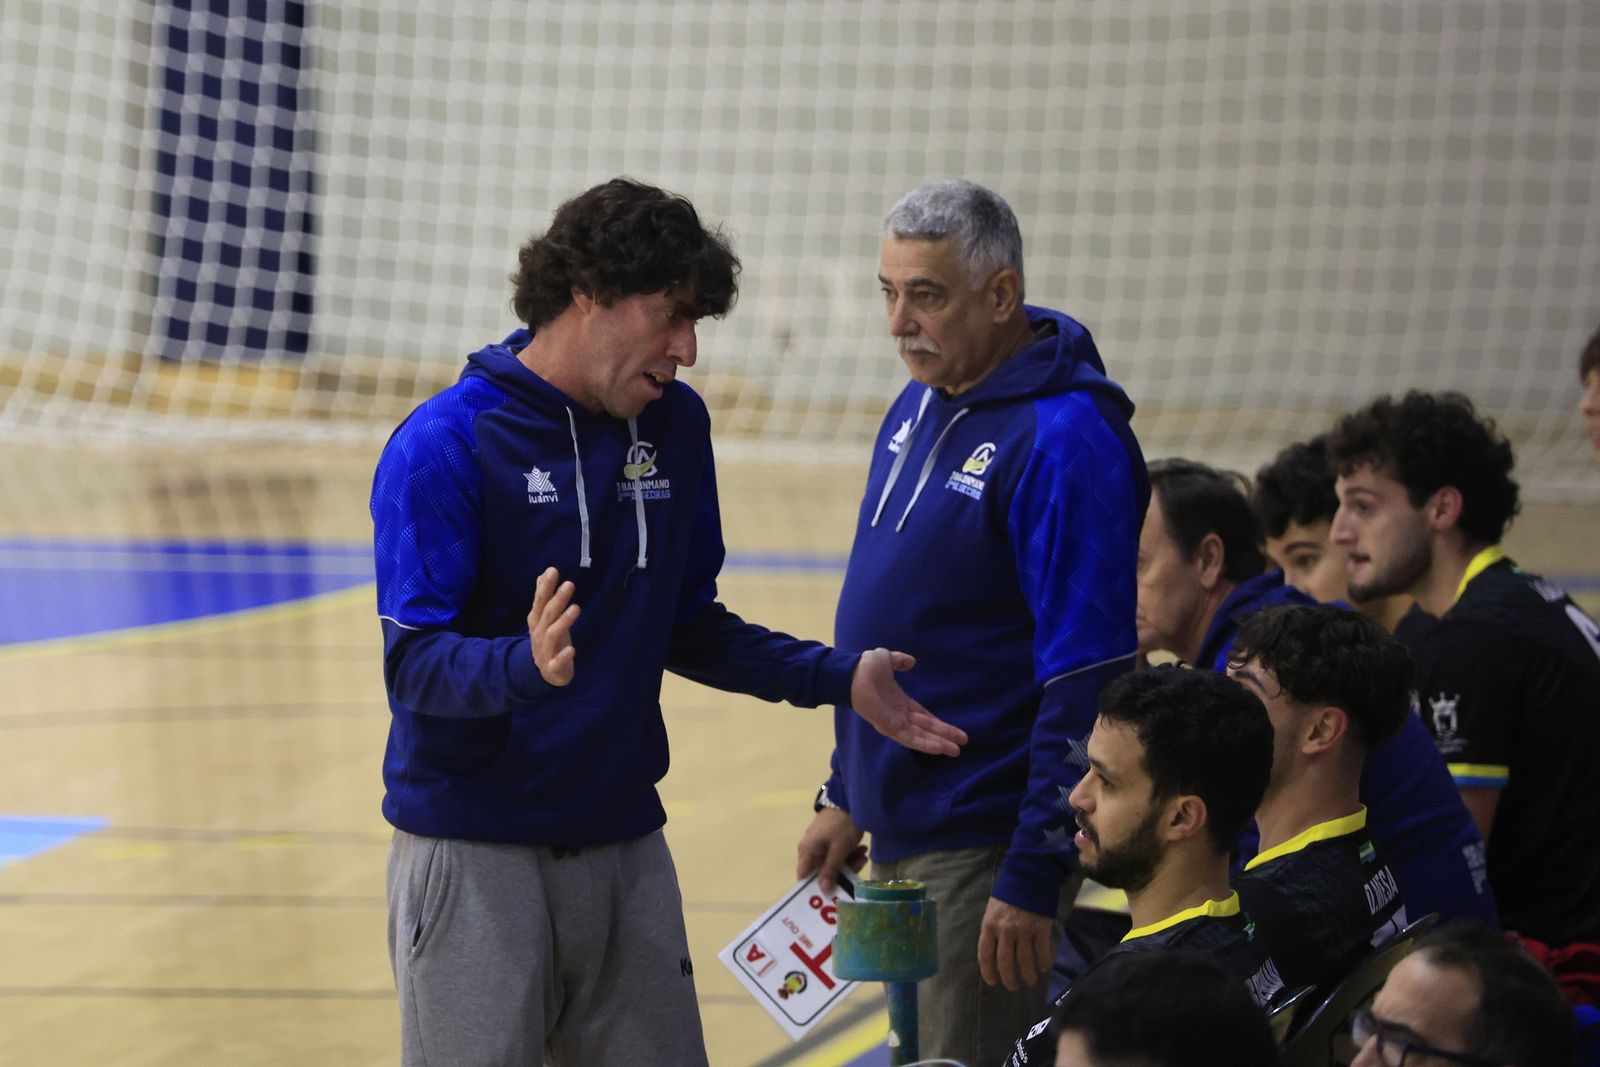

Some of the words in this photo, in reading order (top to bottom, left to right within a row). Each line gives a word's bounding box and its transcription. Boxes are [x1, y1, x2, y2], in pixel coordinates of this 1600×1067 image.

[528, 492, 559, 504] luanvi
[1363, 865, 1399, 916] D.MESA
[782, 917, 800, 935] OUT
[746, 943, 766, 962] A
